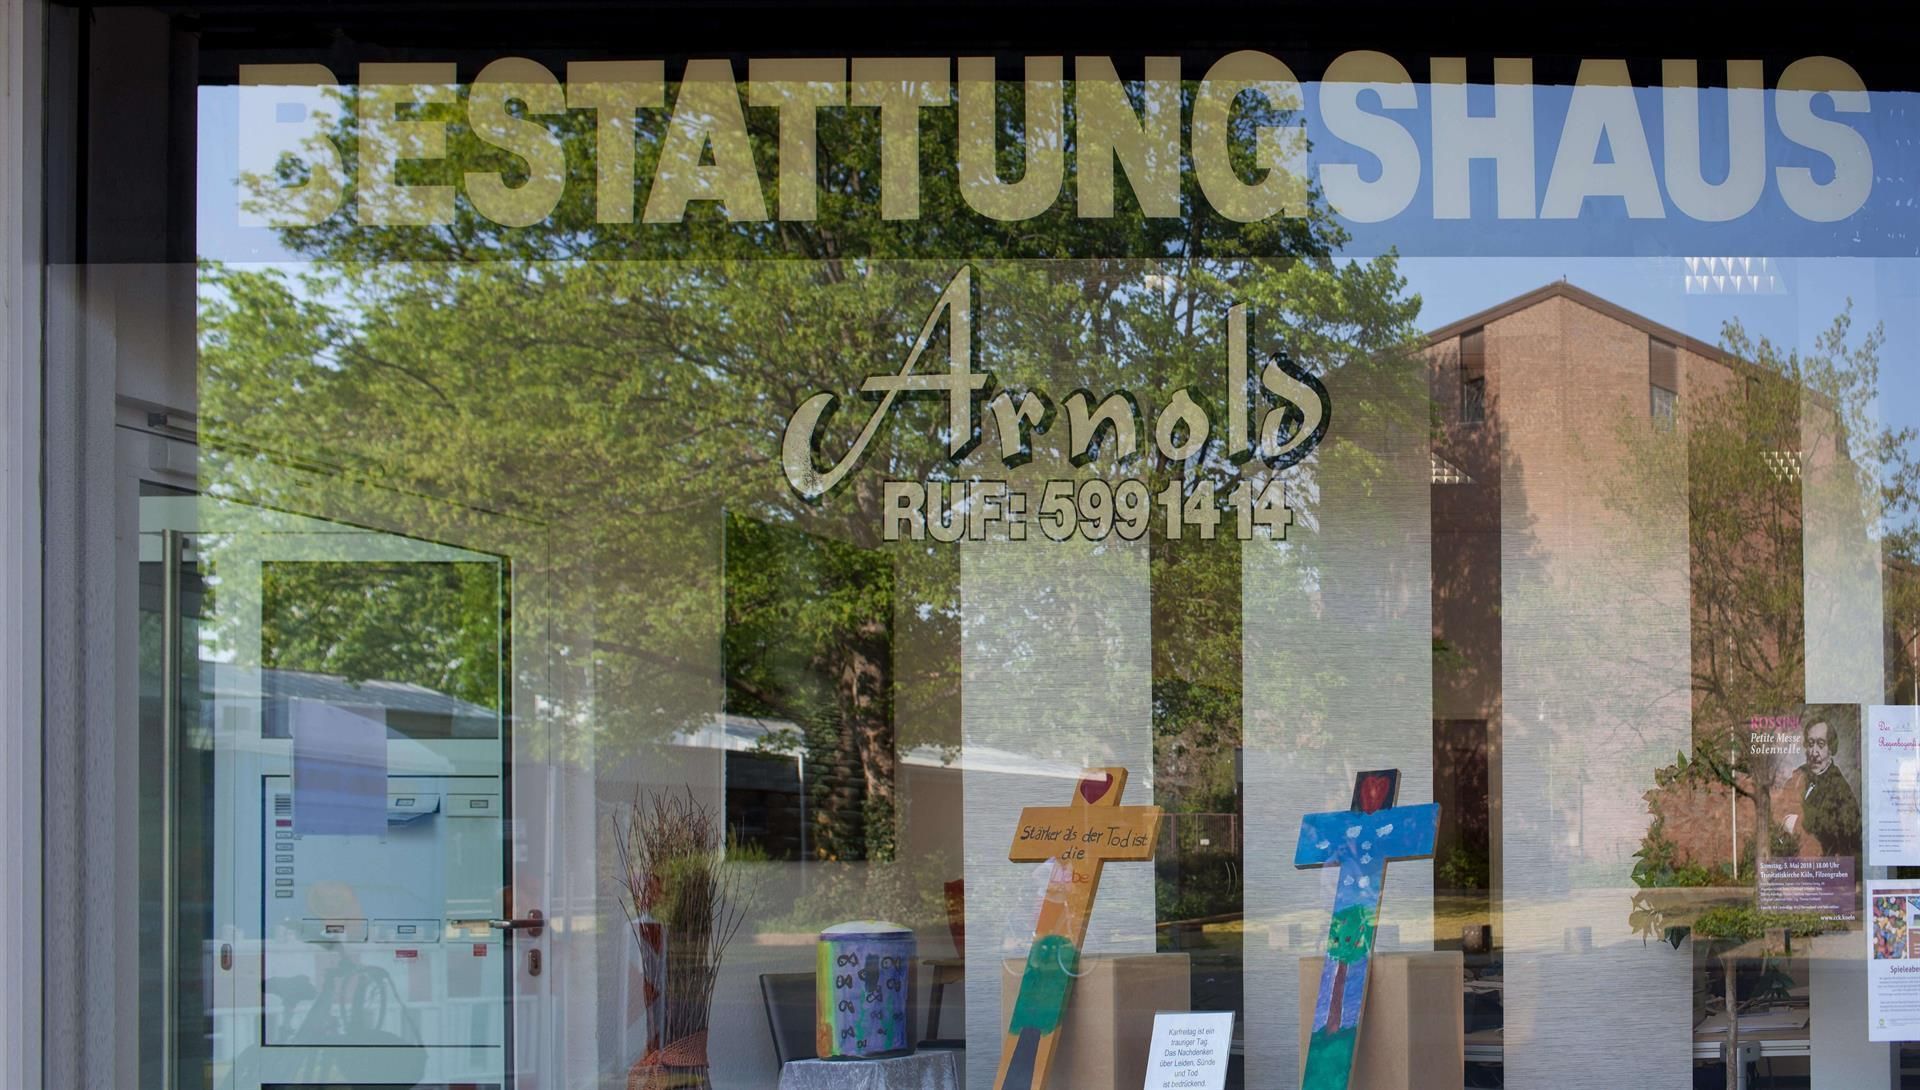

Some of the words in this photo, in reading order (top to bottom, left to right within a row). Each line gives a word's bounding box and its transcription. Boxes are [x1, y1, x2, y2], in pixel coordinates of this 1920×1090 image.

[238, 49, 1874, 227] BESTATTUNGSHAUS
[782, 263, 1332, 498] Arnold
[883, 479, 1027, 542] RUF:
[1039, 478, 1151, 542] 599
[1158, 478, 1222, 541] 14
[1230, 478, 1294, 541] 14
[1750, 732, 1775, 743] Petite
[1776, 732, 1801, 743] Messe
[1750, 743, 1801, 754] Solennelle
[1020, 825, 1062, 842] Stärker
[1082, 826, 1104, 843] der
[1106, 826, 1132, 848] Tod
[1132, 833, 1148, 847] ist
[1061, 846, 1086, 861] die
[1168, 1028, 1196, 1037] Karfreitag
[1170, 1038, 1195, 1047] trauriger
[1196, 1038, 1208, 1047] Tag
[1164, 1049, 1177, 1057] Das
[1177, 1048, 1214, 1056] Nachdenken
[1159, 1059, 1173, 1067] über
[1196, 1058, 1216, 1066] Sünde
[1174, 1069, 1185, 1077] und
[1187, 1069, 1198, 1077] Tod
[1162, 1080, 1170, 1088] ist
[1171, 1079, 1207, 1088] bedrückend.
